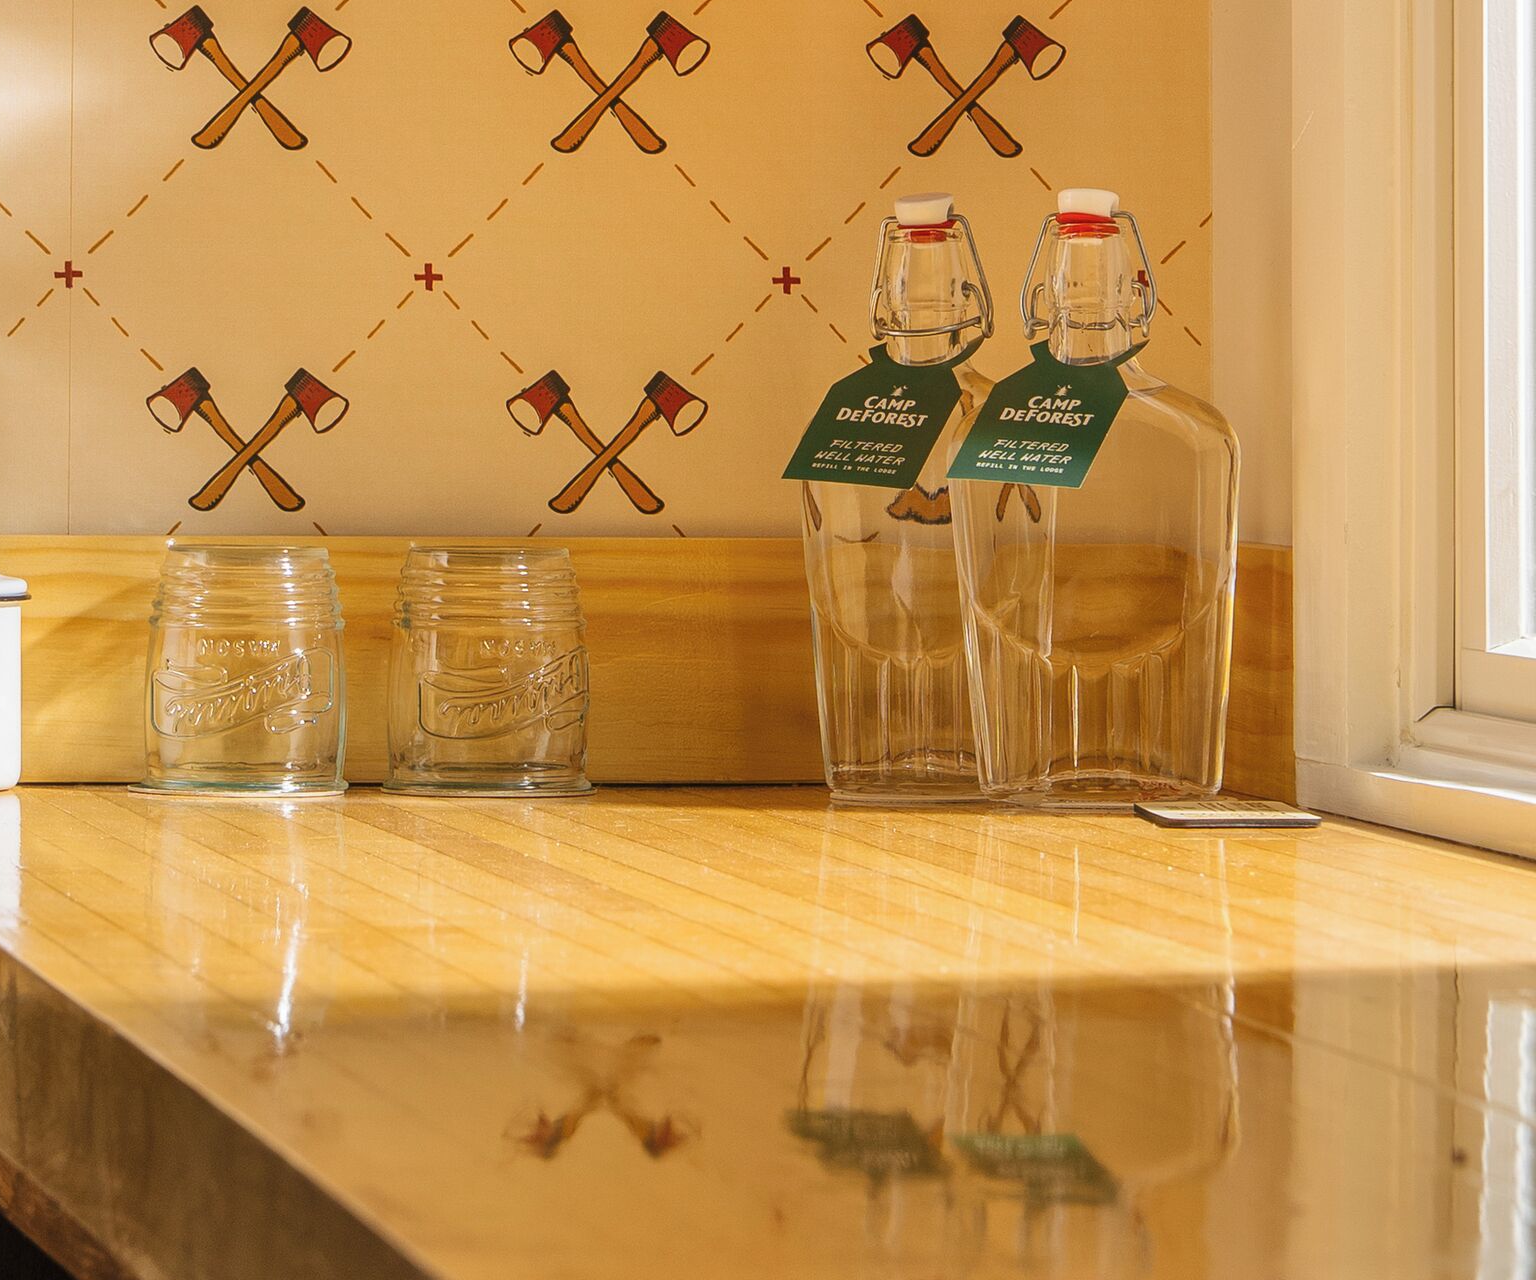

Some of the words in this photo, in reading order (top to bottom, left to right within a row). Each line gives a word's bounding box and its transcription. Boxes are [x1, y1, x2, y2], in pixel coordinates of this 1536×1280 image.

[864, 396, 916, 411] CAMP
[1028, 396, 1081, 411] CAMP
[830, 439, 903, 453] FILTERED
[994, 439, 1069, 452] FILTERED
[814, 450, 850, 461] WELL
[855, 453, 905, 466] WATER
[978, 450, 1016, 461] WELL
[1020, 453, 1073, 465] WATER
